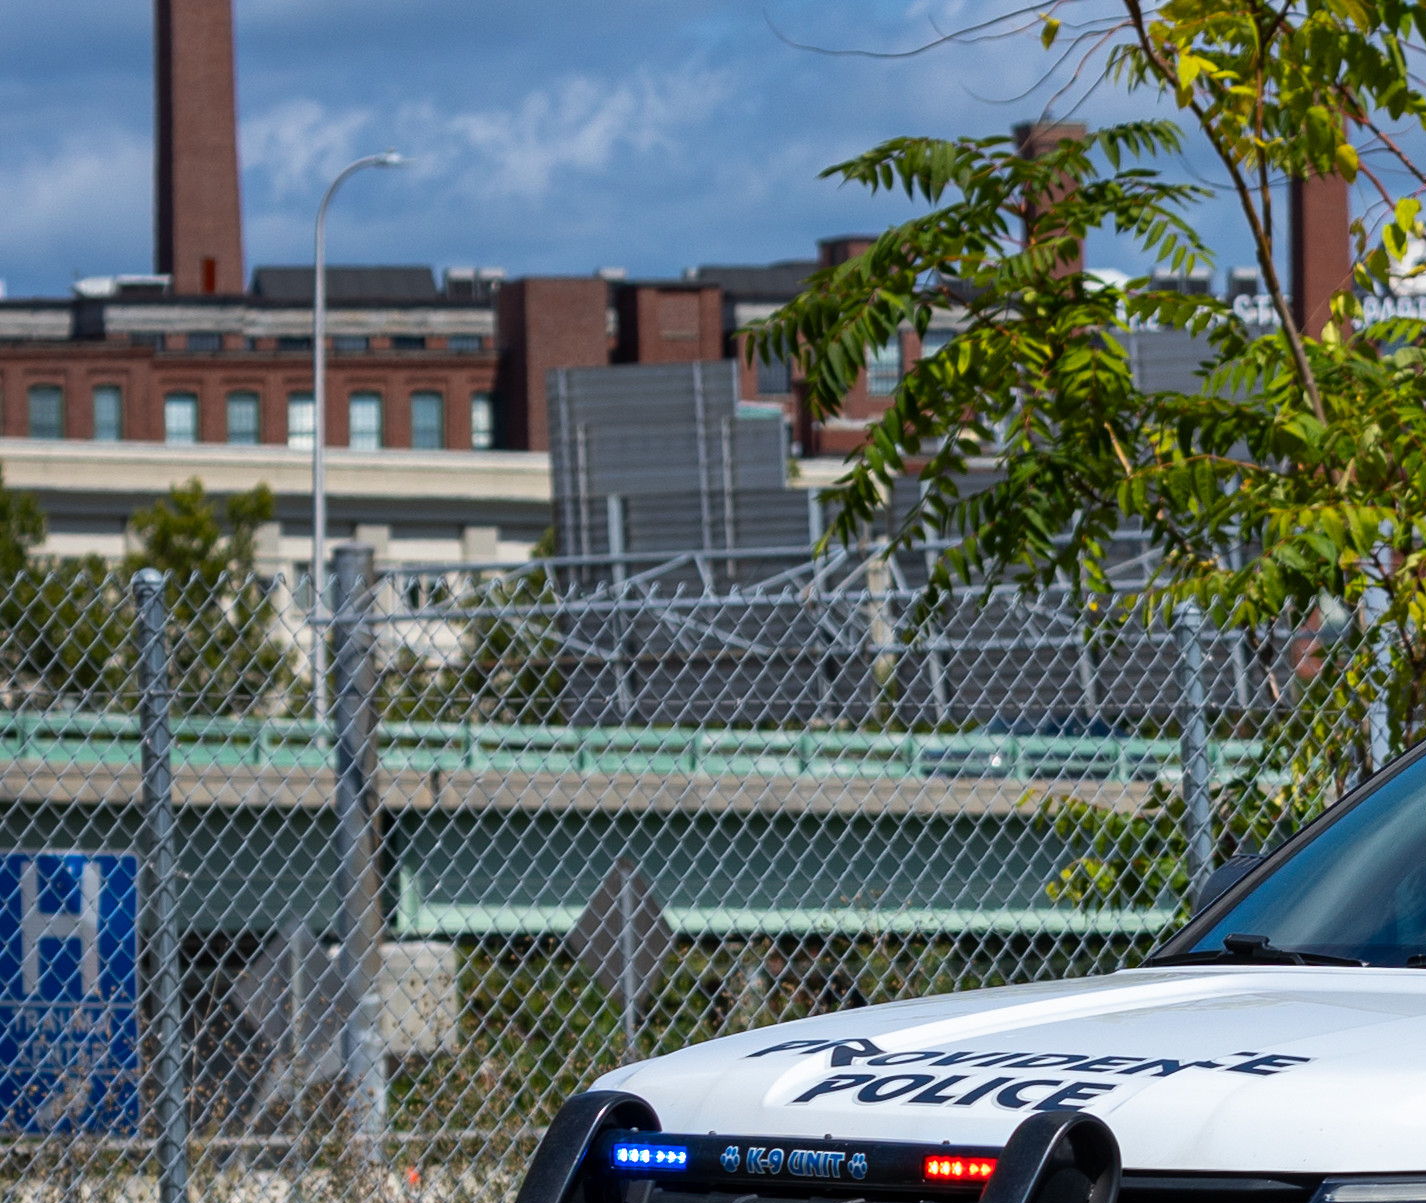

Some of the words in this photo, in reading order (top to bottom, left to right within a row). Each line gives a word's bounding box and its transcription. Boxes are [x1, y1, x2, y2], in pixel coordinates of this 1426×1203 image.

[20, 860, 99, 996] H
[789, 1072, 1117, 1112] POLICE
[745, 1147, 784, 1174] K-9
[788, 1149, 846, 1178] UNIT
